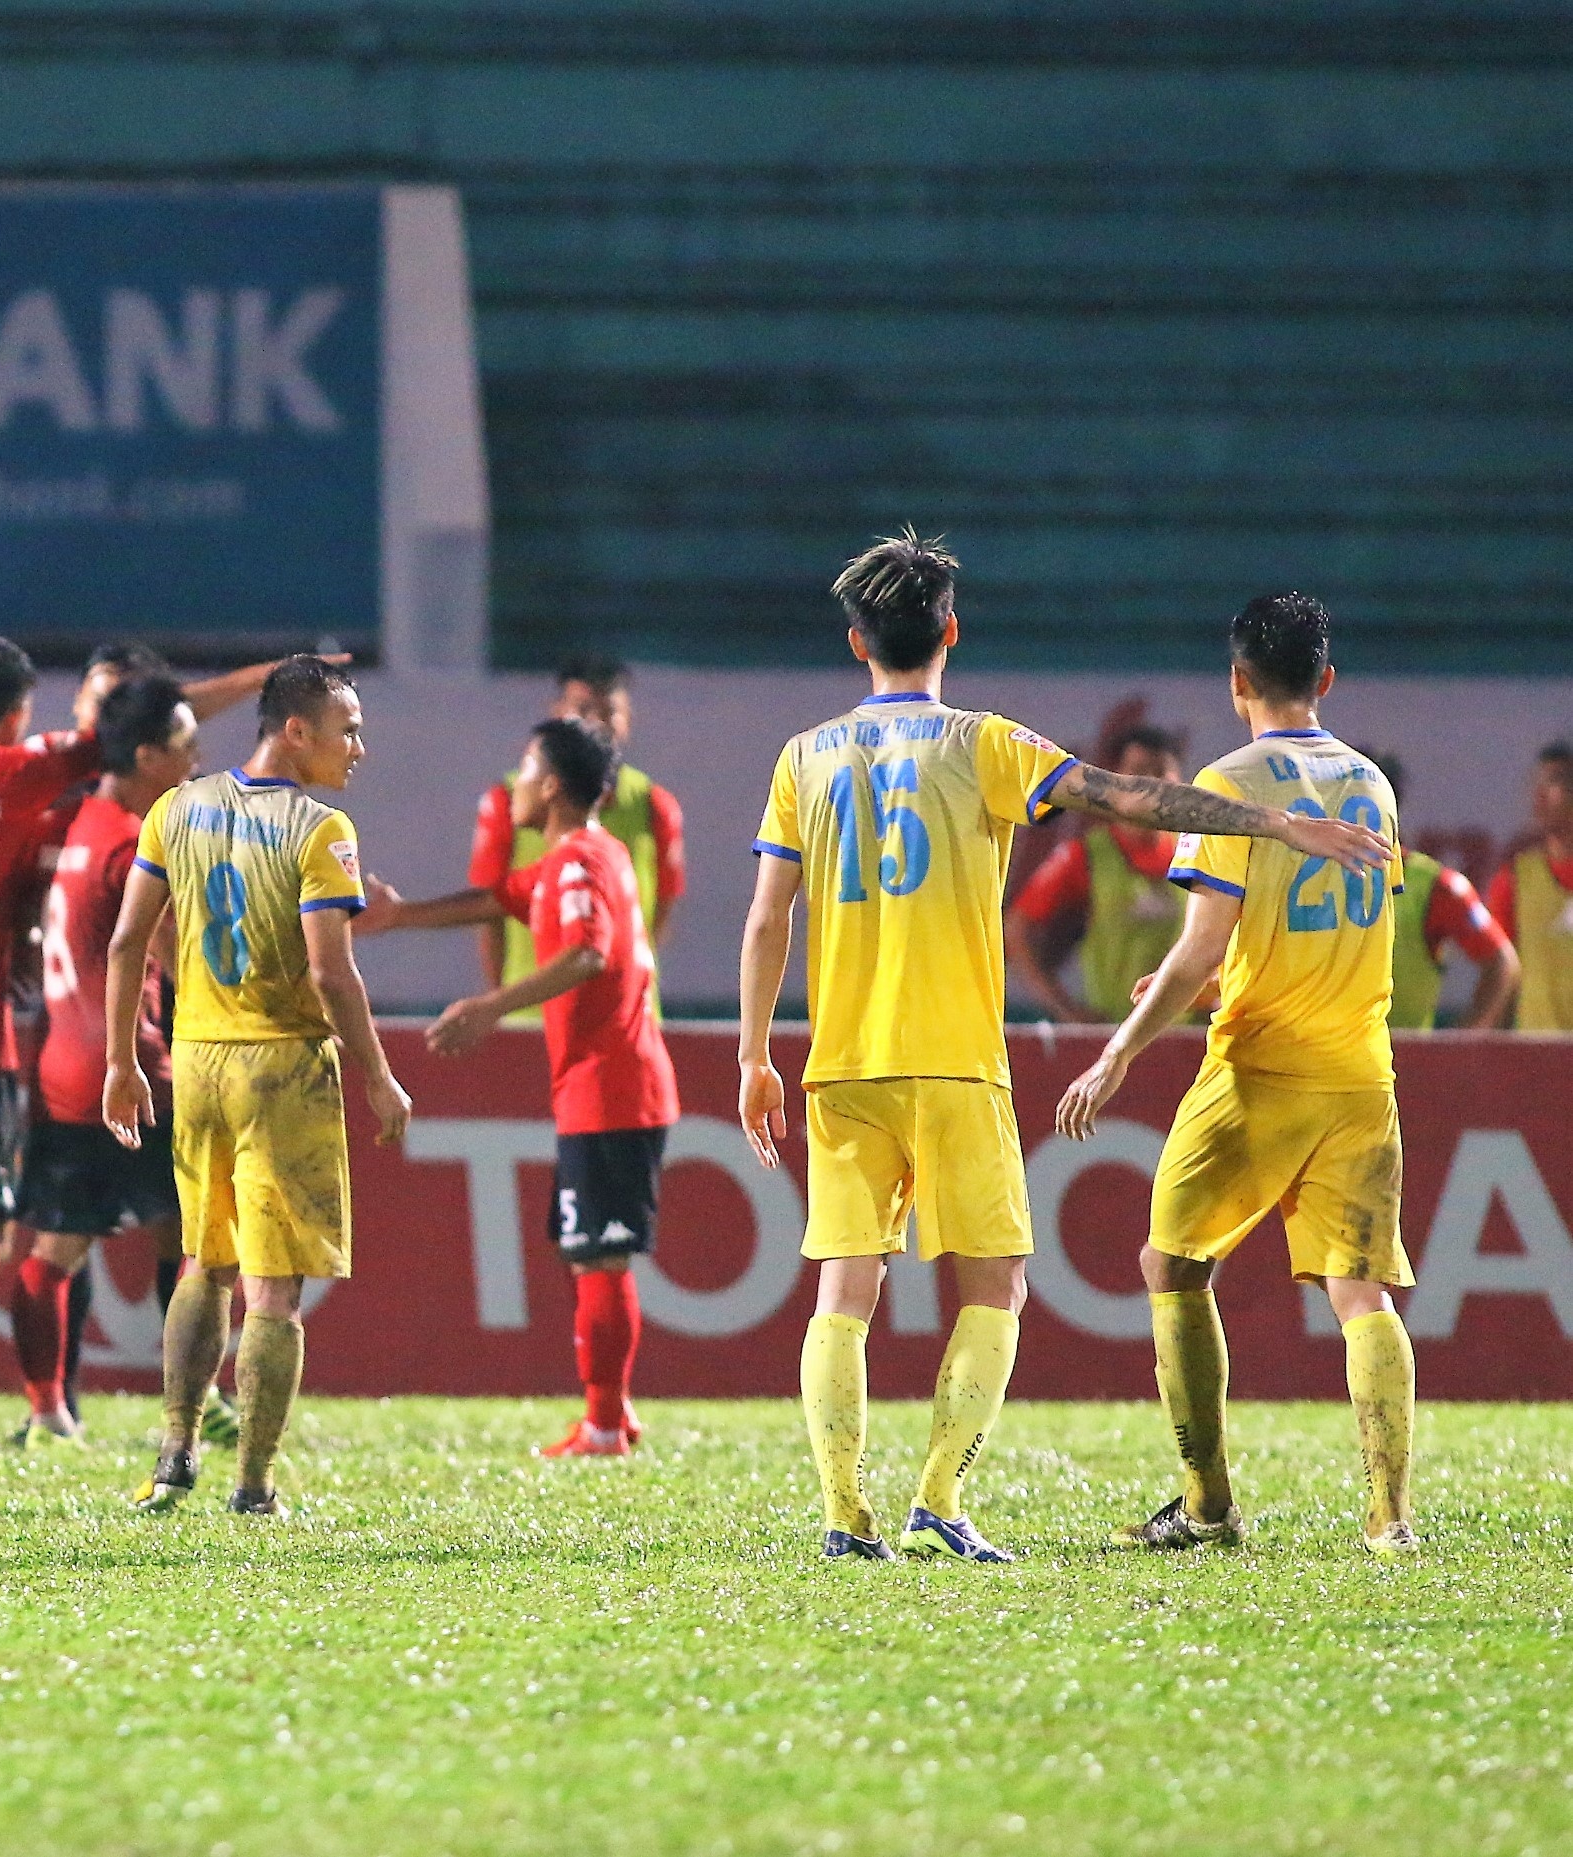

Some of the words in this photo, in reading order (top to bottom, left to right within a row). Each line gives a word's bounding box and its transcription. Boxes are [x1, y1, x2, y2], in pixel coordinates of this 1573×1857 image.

[829, 757, 931, 903] 15
[202, 861, 251, 987] 8
[403, 1113, 1573, 1340] TOOA
[559, 1188, 577, 1233] 5
[955, 1432, 985, 1479] mitre
